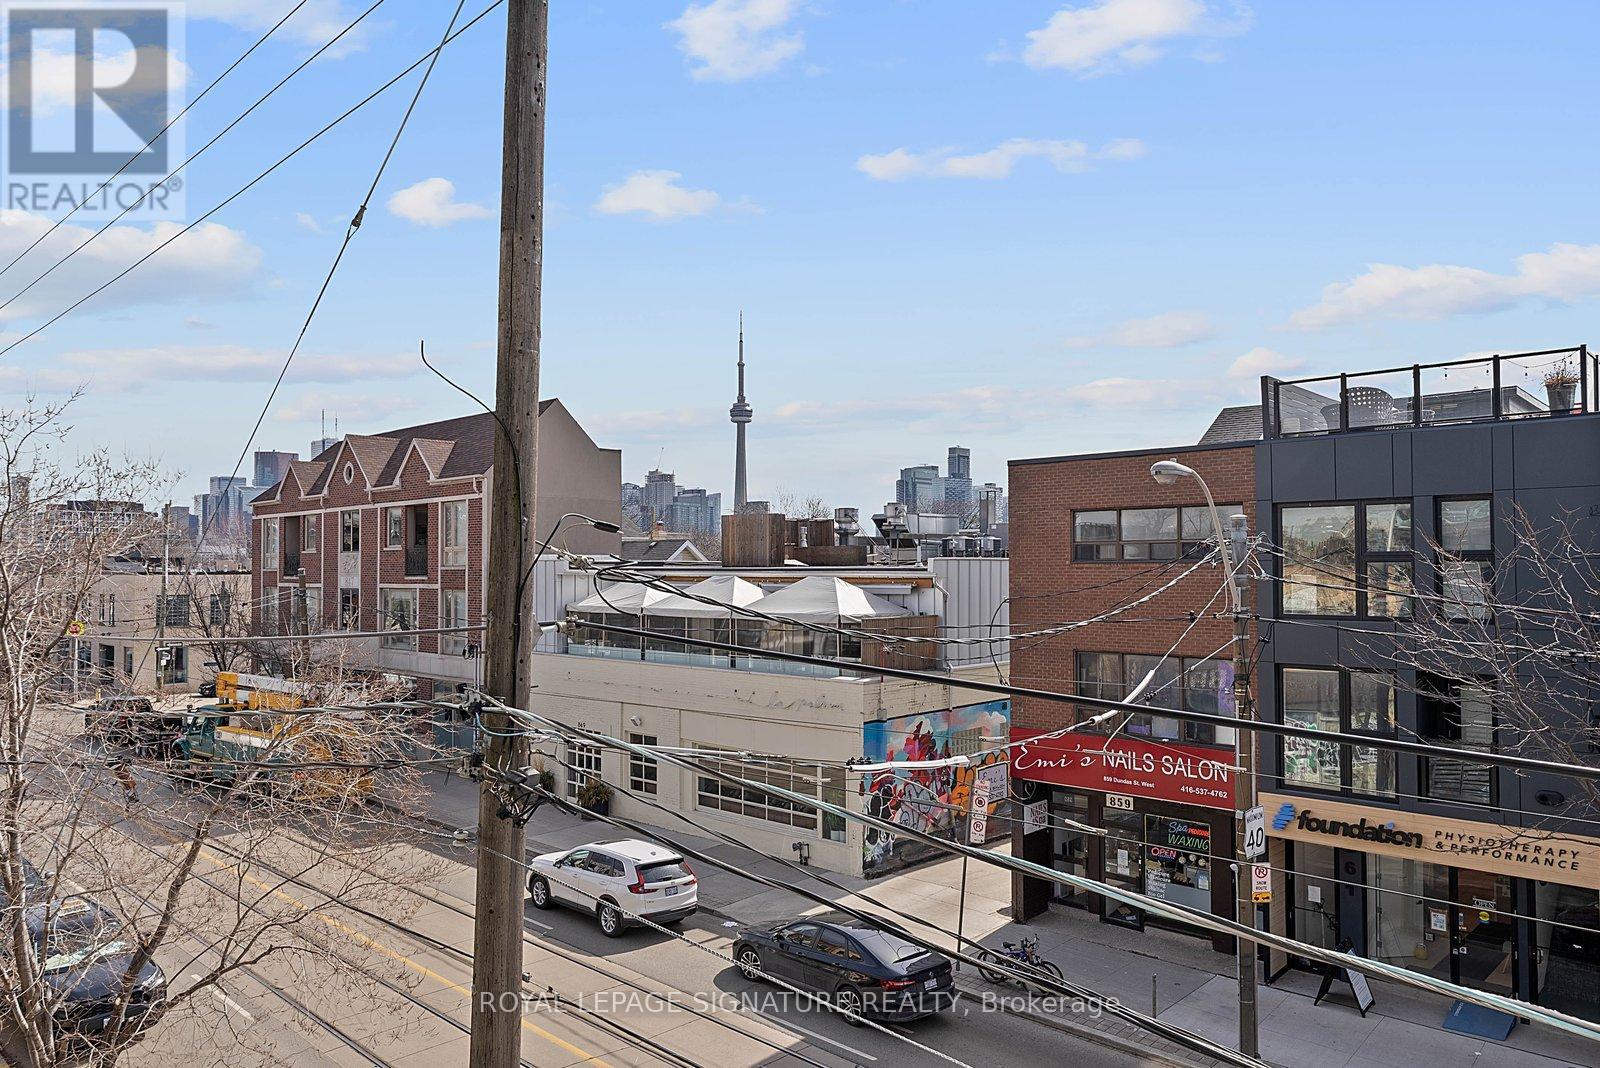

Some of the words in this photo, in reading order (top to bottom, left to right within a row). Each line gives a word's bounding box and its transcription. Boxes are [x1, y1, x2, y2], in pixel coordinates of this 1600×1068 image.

[1014, 738, 1095, 770] Emi's
[1102, 748, 1155, 773] NAILS
[1161, 755, 1229, 783] SALON
[1113, 777, 1133, 787] Dundas
[1141, 780, 1155, 789] West
[1180, 785, 1228, 799] 416-537-4762
[1109, 797, 1131, 809] 859
[1168, 821, 1188, 833] Spa
[1297, 810, 1423, 849] foundation
[1168, 834, 1209, 850] WAXING
[1246, 827, 1264, 850] 40
[1434, 830, 1580, 859] PHYSIOTHERAPY
[1151, 847, 1177, 857] OPEN
[1435, 841, 1444, 850] &
[1450, 842, 1580, 871] PERFORMANCE
[1474, 900, 1495, 909] OPEN
